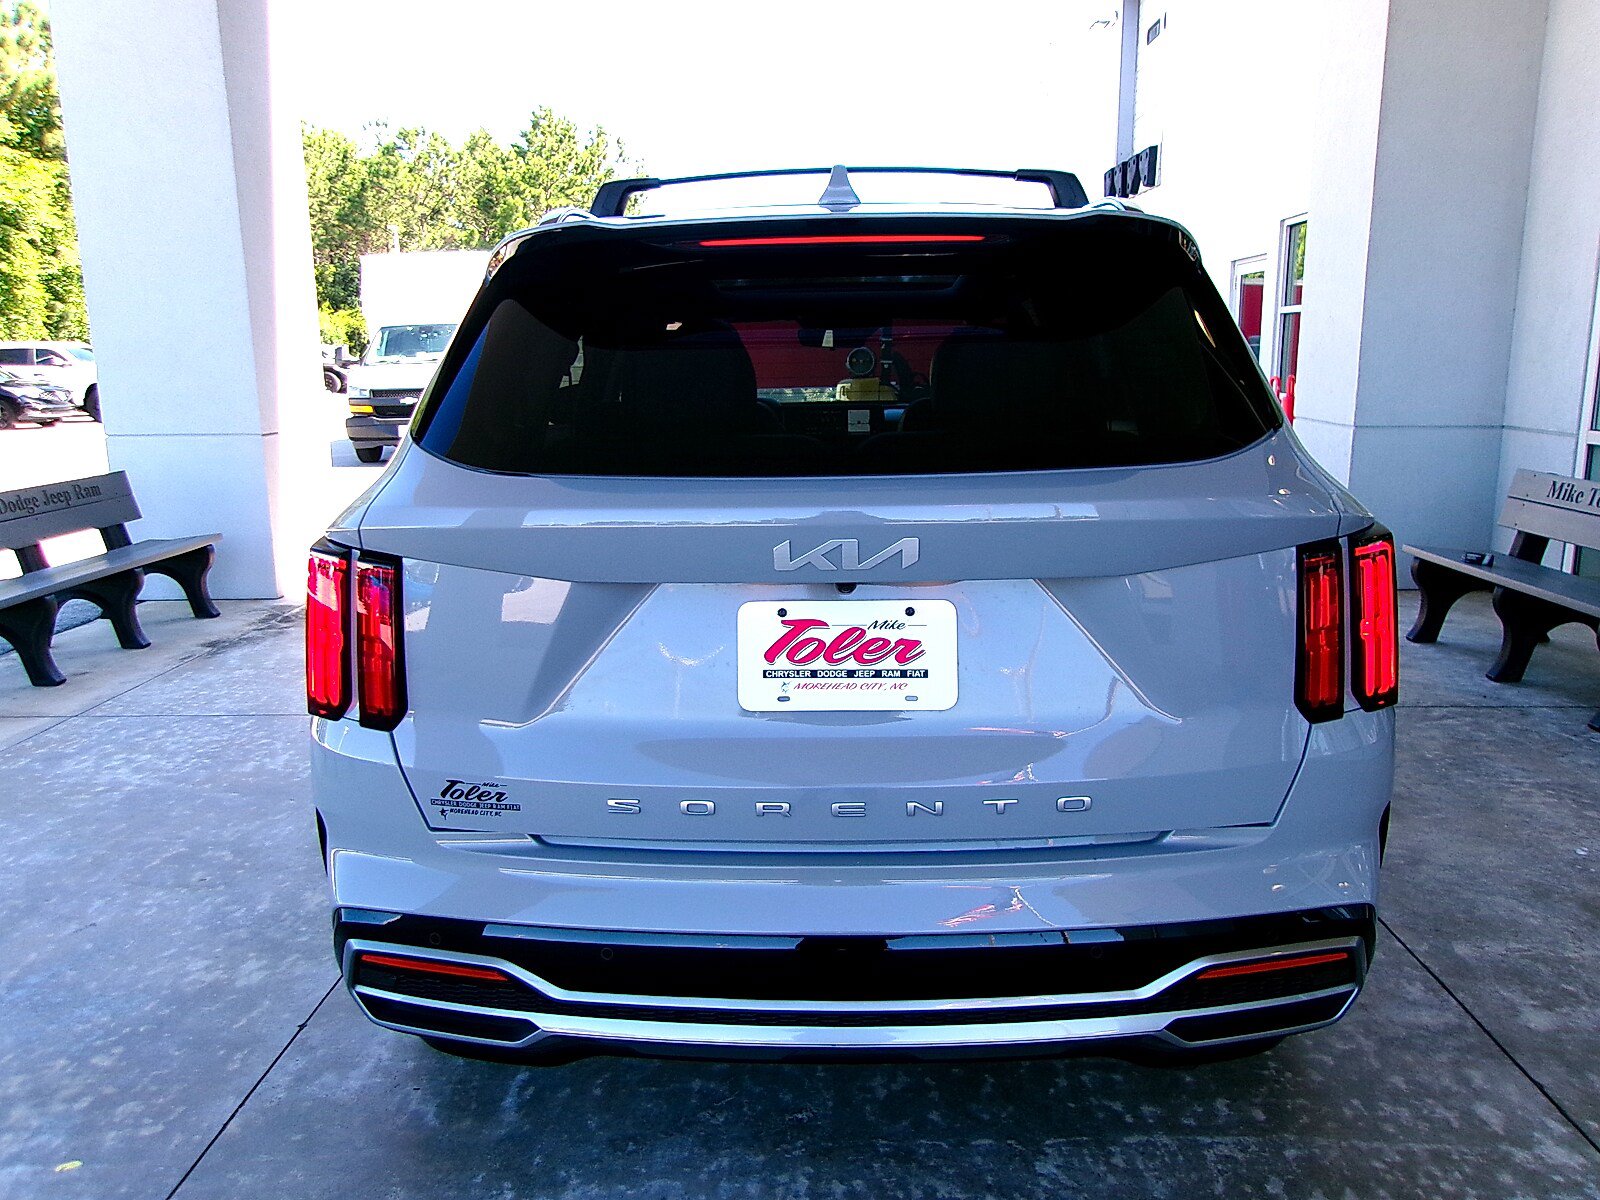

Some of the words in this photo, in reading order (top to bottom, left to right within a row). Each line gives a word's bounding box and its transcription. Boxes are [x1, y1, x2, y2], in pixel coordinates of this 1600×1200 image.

[0, 495, 40, 514] Dodge
[42, 489, 72, 506] Jeep
[72, 484, 102, 500] Ram
[1546, 480, 1584, 504] Mike
[773, 536, 920, 571] KIA
[867, 620, 906, 630] Mike
[763, 618, 926, 666] Toler
[765, 670, 811, 678] CHRYSLER
[817, 670, 848, 678] DODGE
[853, 670, 875, 678] JEEP
[881, 670, 901, 678] RAM
[907, 670, 925, 678] FIAT
[793, 682, 857, 690] MOREHEAD
[889, 682, 908, 690] NC
[440, 779, 508, 802] Toler
[607, 795, 1092, 818] SORENTO
